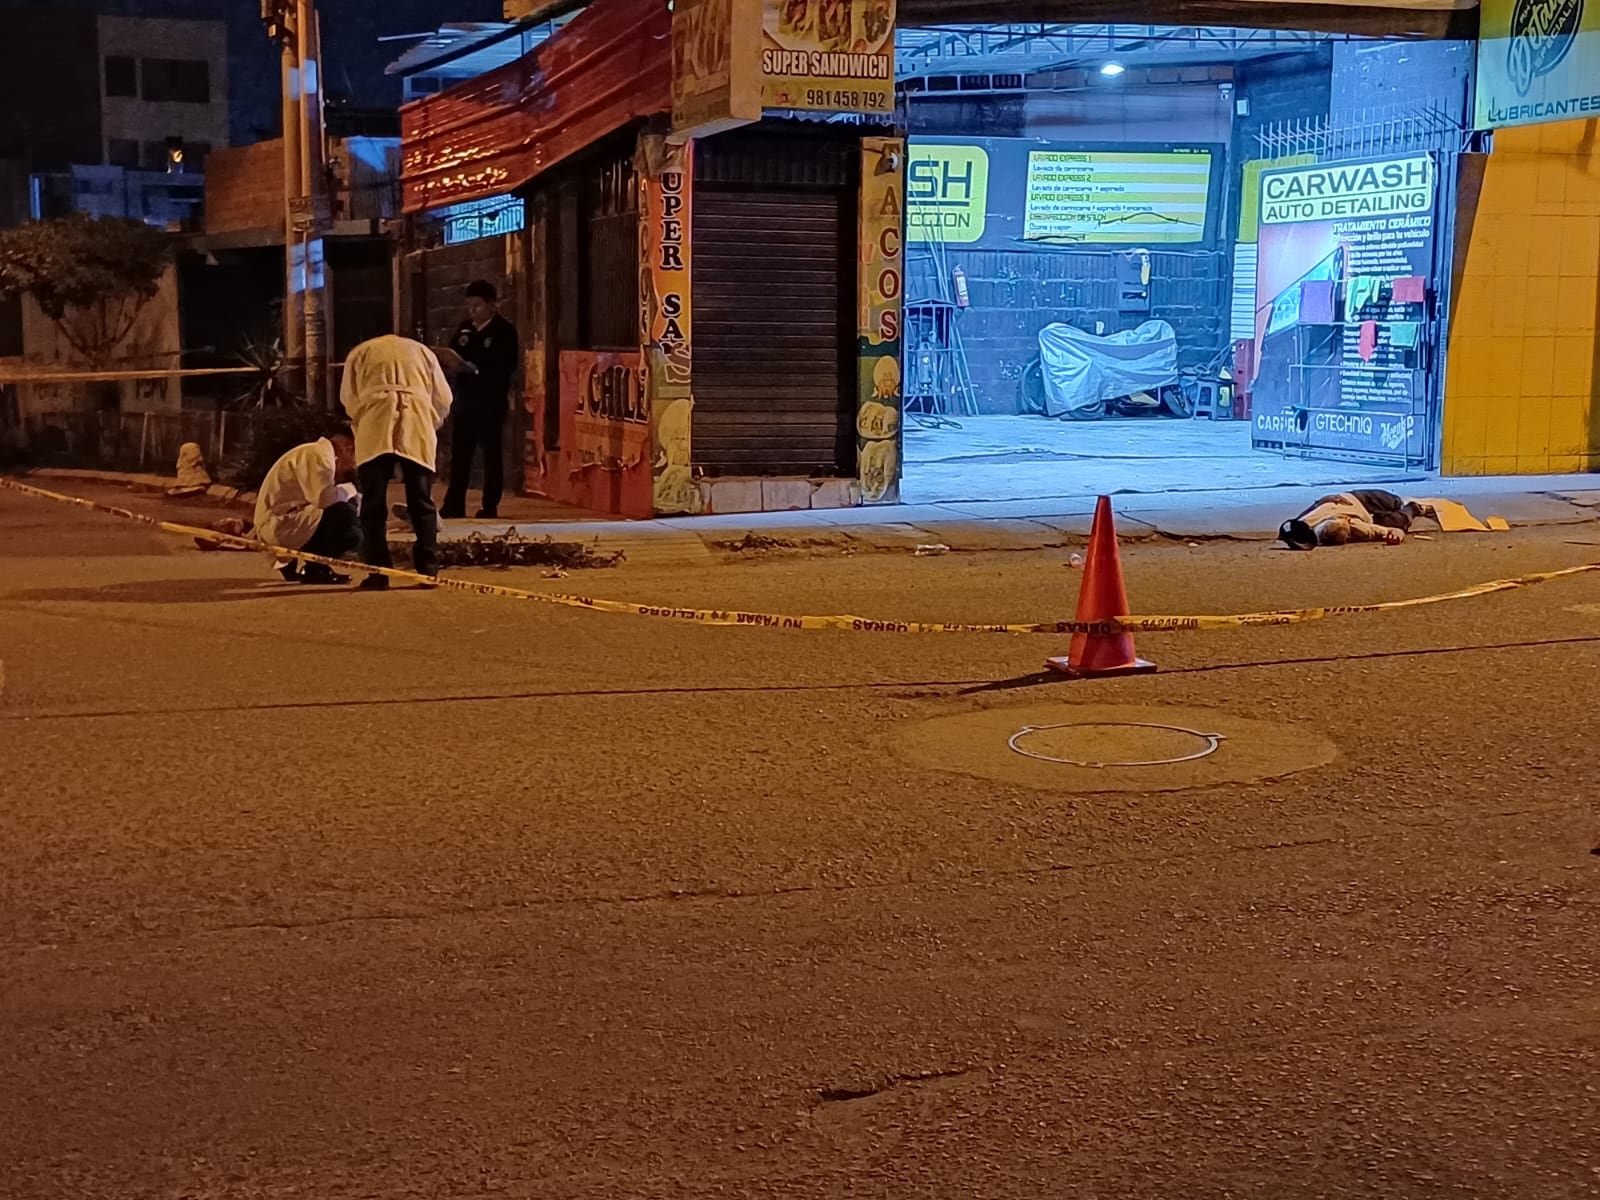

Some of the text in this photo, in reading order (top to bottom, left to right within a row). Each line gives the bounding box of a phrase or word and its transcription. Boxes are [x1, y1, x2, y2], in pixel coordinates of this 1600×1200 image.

[762, 48, 889, 79] SUPER SANDWICH
[1487, 96, 1600, 122] LUBRICANTES
[1266, 159, 1427, 199] CARWASH
[1266, 193, 1425, 220] AUTO DETAILING
[659, 170, 685, 271] UPER
[907, 212, 971, 228] CCION
[1333, 213, 1431, 233] TRATAMIENTO CERÁMICO
[1315, 413, 1373, 435] GTECHNIQ
